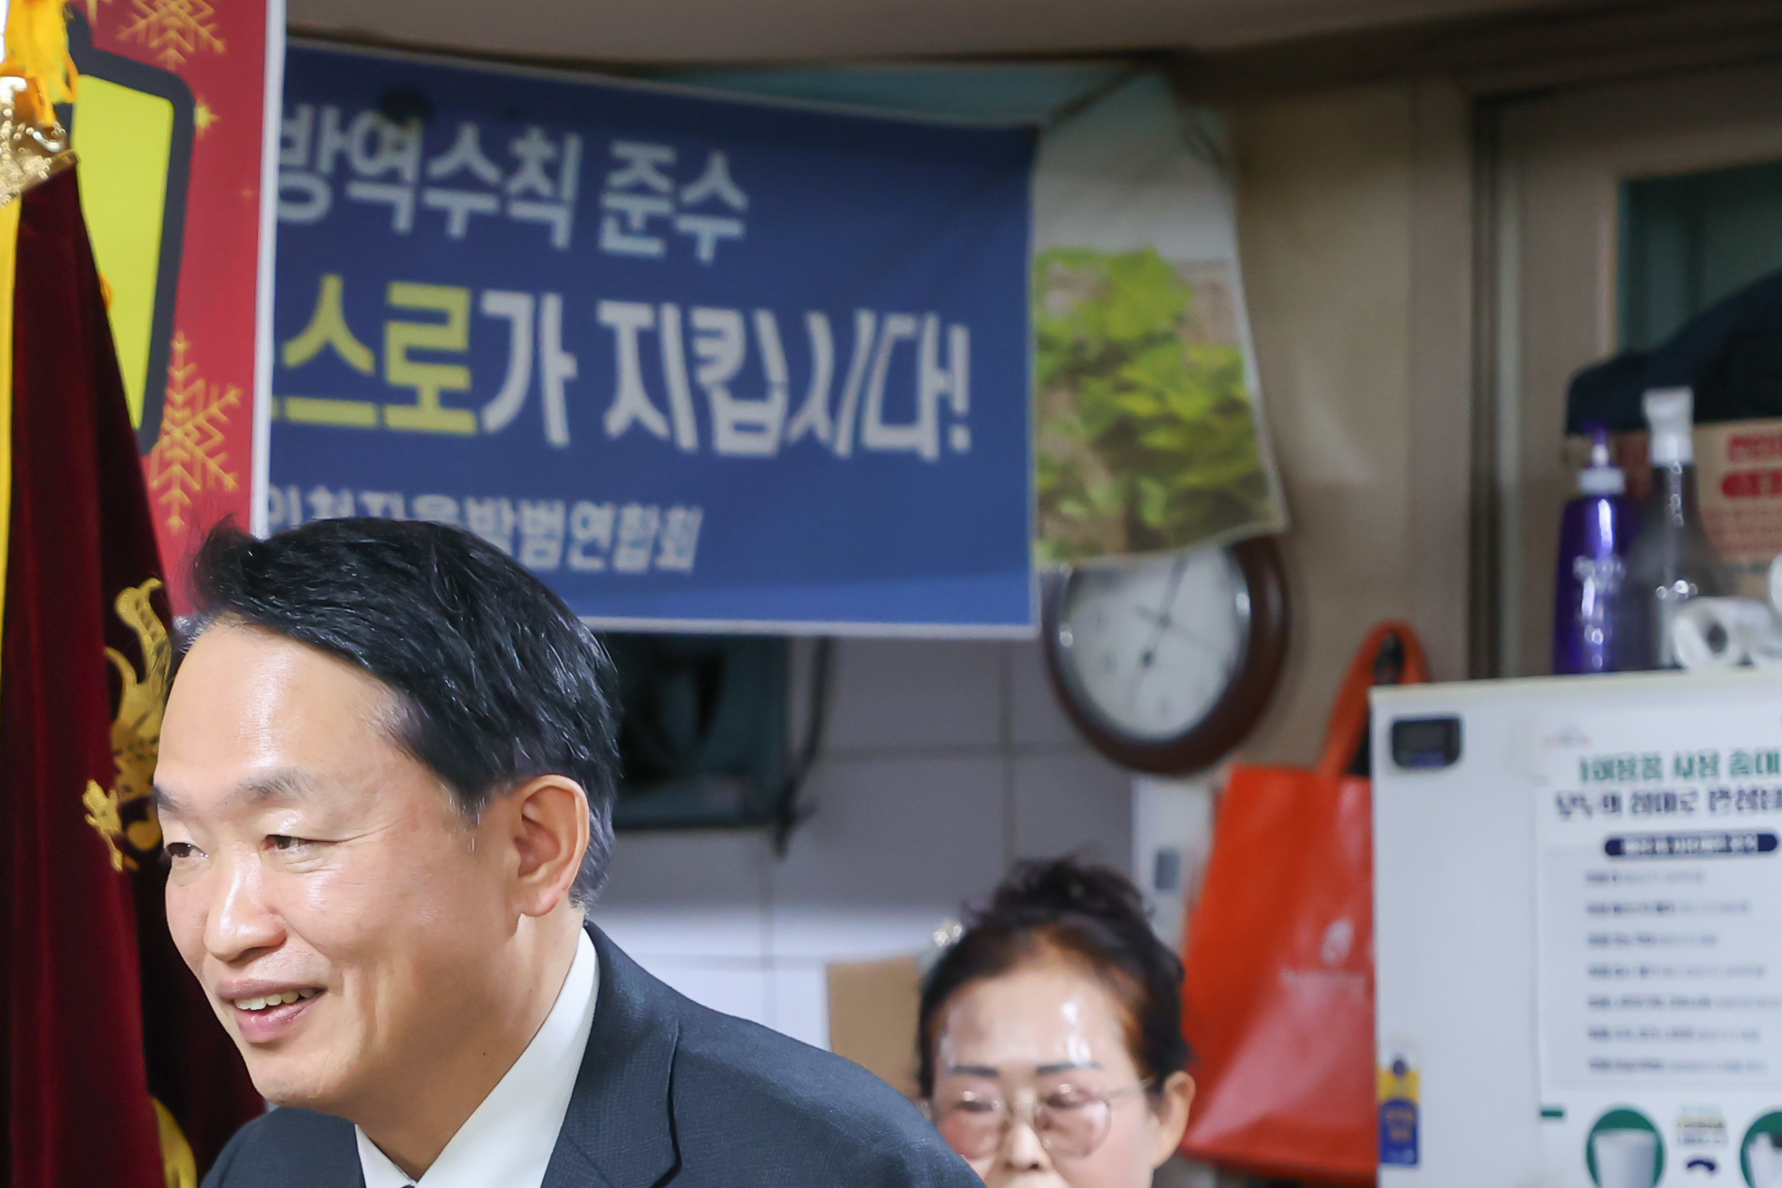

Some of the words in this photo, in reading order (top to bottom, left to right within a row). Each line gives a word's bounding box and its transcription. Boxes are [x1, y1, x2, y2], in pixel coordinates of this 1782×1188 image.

[277, 103, 582, 249] 방역수칙
[599, 140, 748, 263] 준수
[271, 274, 577, 446] 스로가
[596, 297, 970, 460] 지킵시다!
